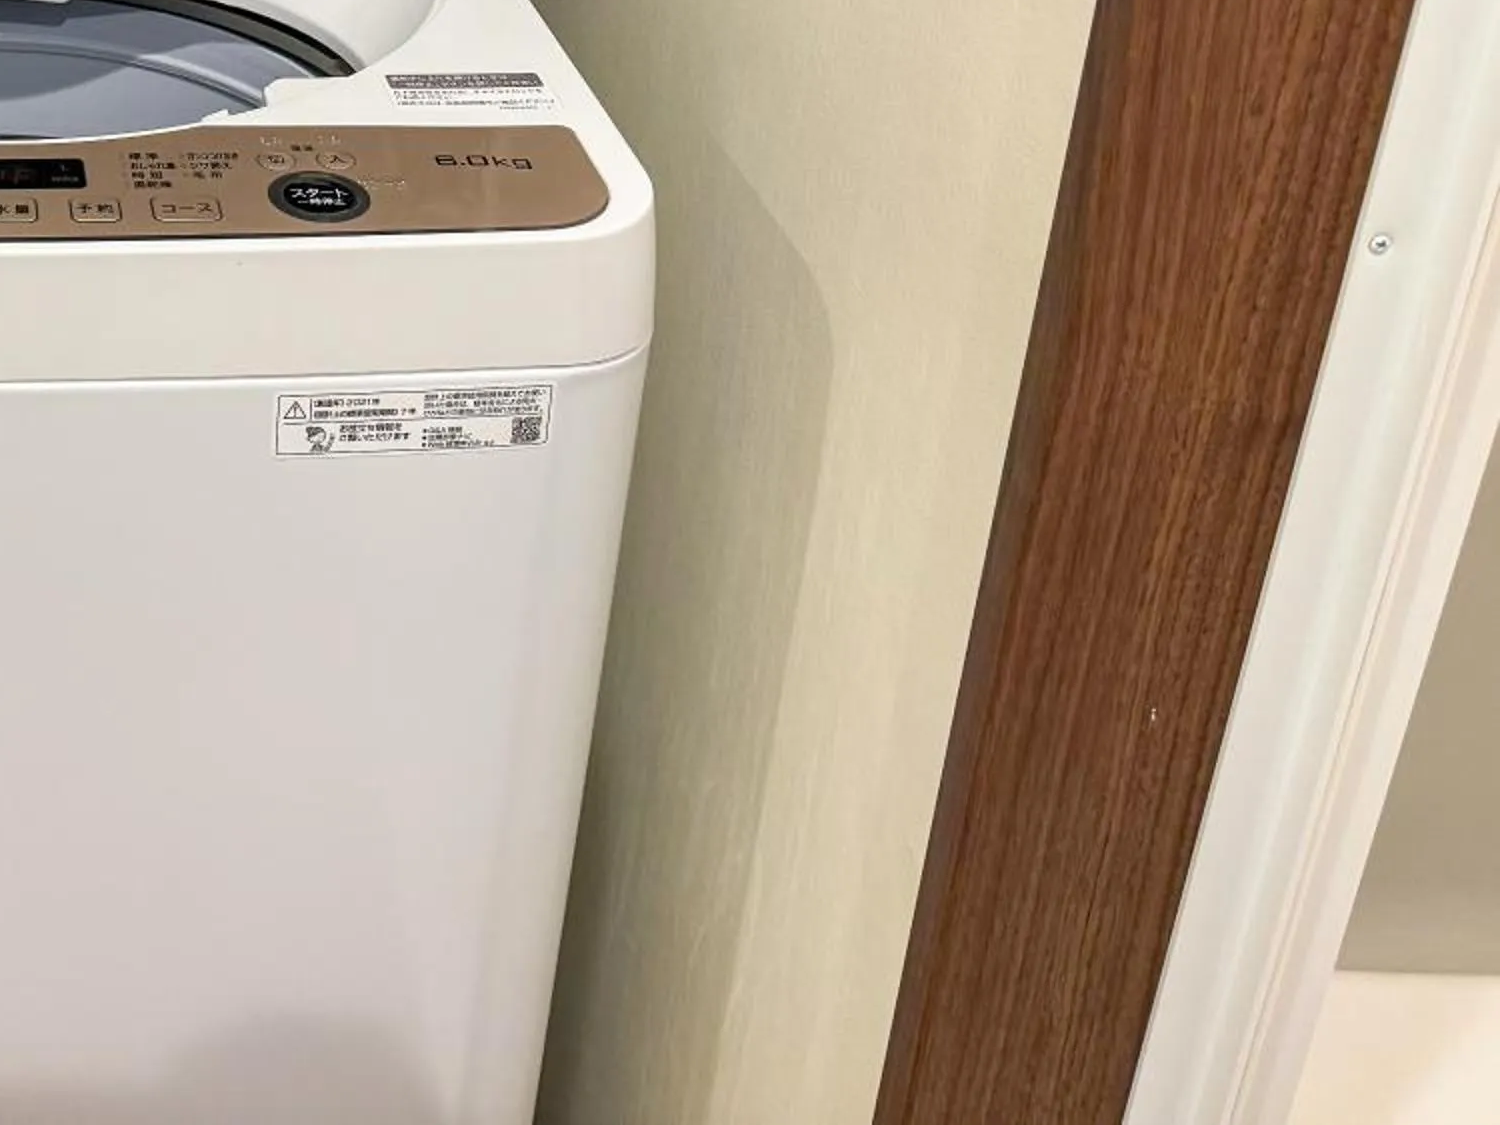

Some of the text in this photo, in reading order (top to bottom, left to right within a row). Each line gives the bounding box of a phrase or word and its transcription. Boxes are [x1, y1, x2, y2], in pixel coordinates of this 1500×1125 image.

[289, 188, 348, 199] スタート
[161, 203, 213, 214] コース
